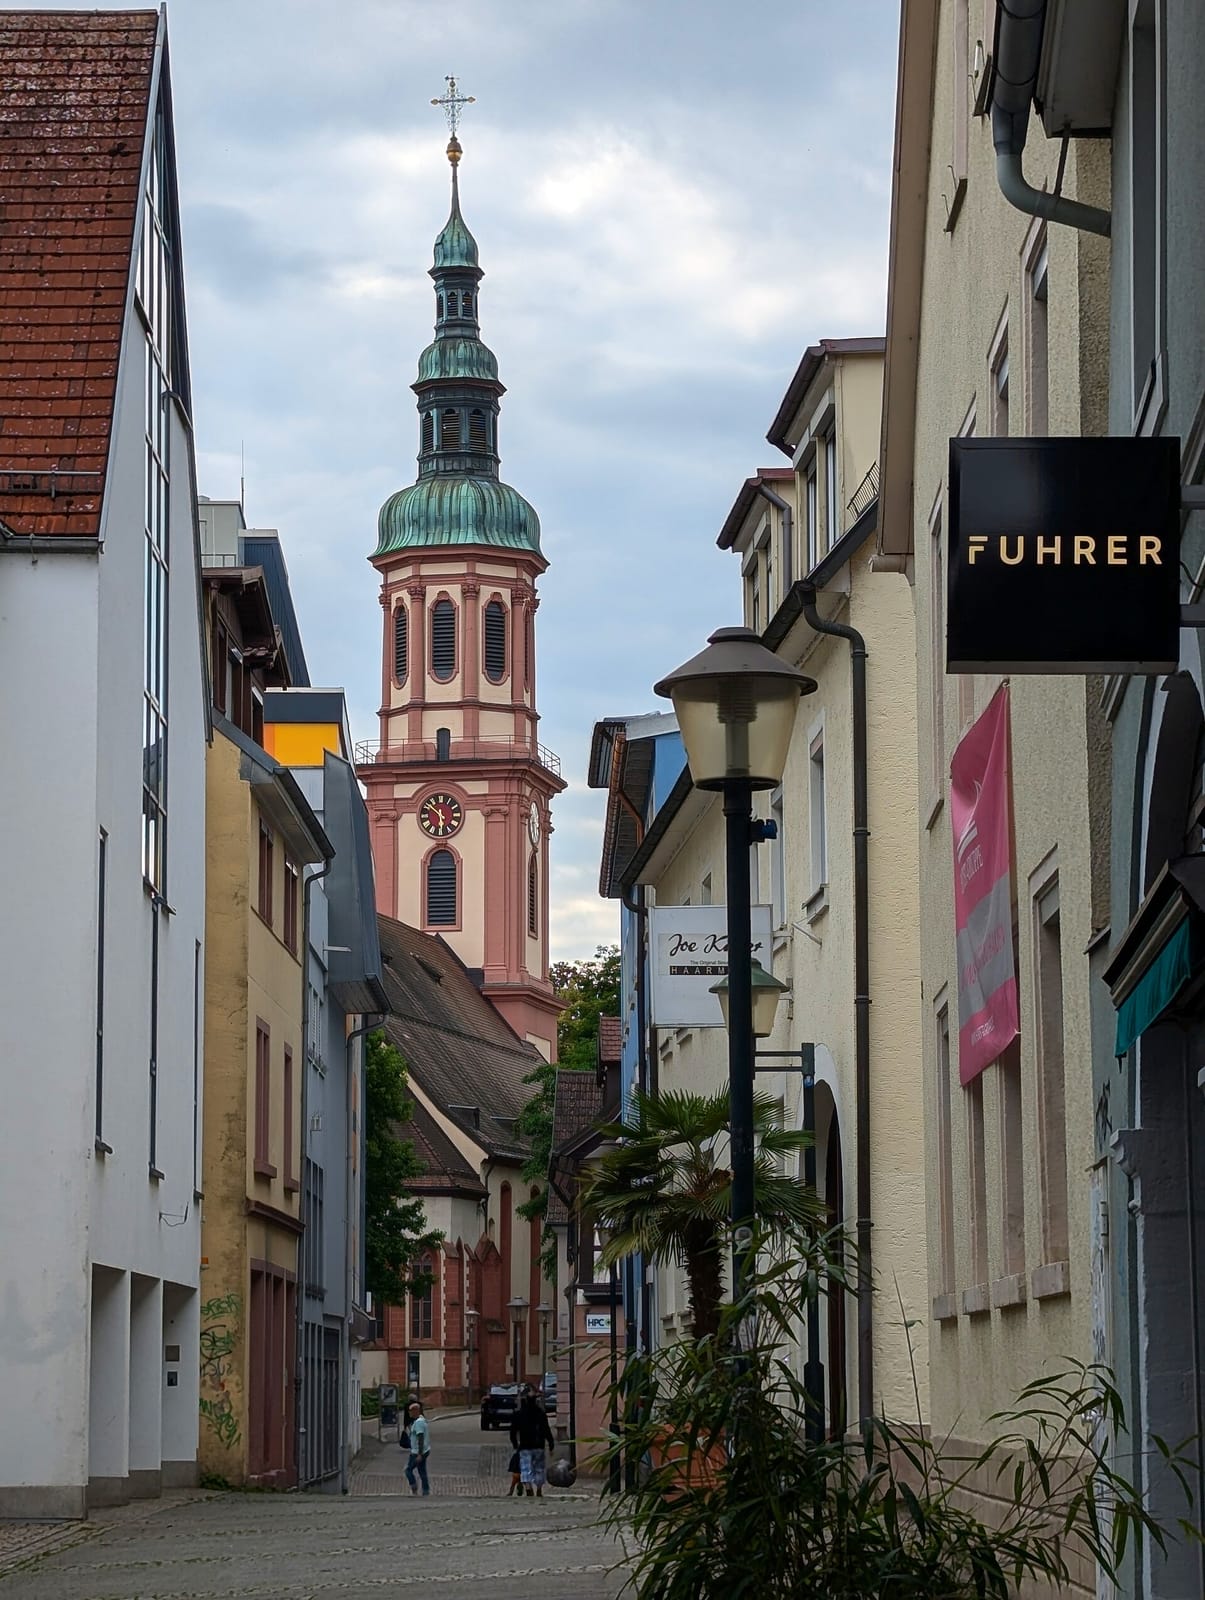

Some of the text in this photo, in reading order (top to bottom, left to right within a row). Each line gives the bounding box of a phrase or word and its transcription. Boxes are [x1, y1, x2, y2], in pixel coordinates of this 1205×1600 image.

[968, 535, 1163, 565] FUHRER
[668, 933, 698, 956] Joe
[670, 966, 727, 975] HAARM
[588, 1318, 605, 1327] HPC
